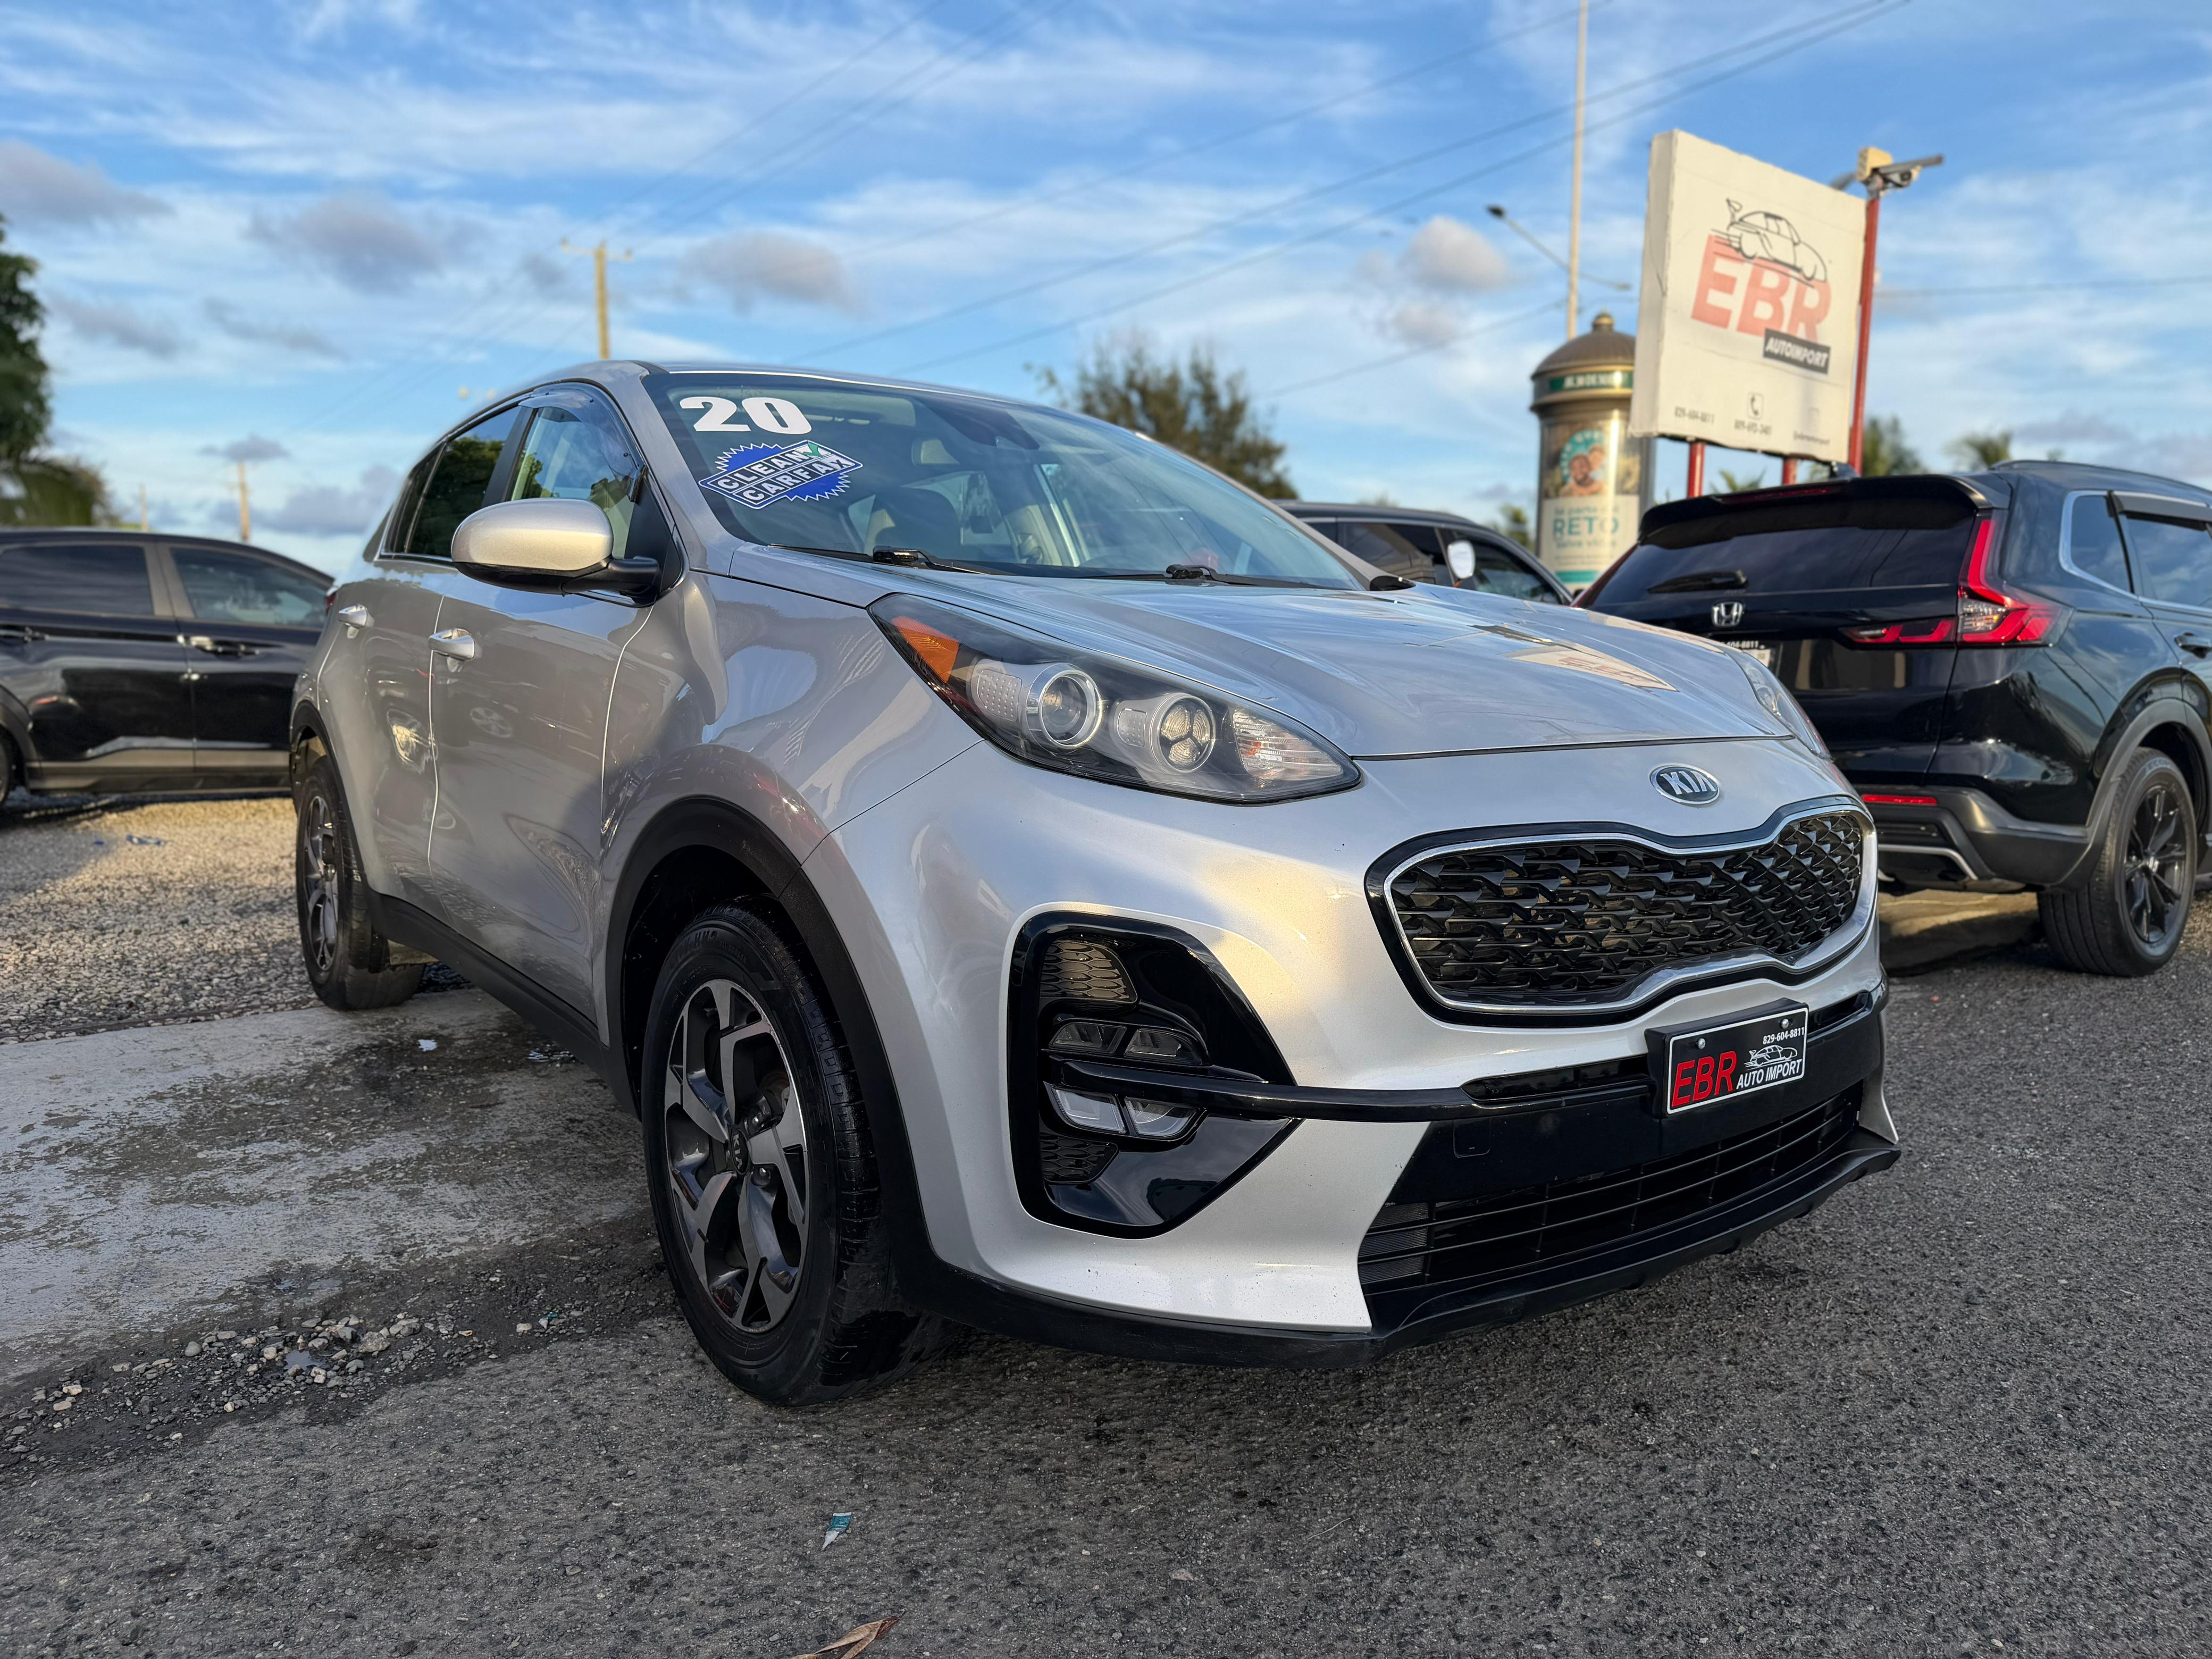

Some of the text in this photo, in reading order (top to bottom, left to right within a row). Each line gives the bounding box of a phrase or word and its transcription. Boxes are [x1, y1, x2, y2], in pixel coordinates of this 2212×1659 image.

[1691, 234, 1831, 344] EBR
[1766, 337, 1828, 367] AUTOIMPORT
[680, 397, 812, 434] 20
[718, 451, 810, 489] CLEAN
[743, 459, 847, 500] CARFAX
[1553, 516, 1619, 541] RETO
[1660, 771, 1716, 795] KIA
[1763, 1027, 1804, 1044] 829-604-8811
[1672, 1051, 1737, 1107] EBR
[1736, 1059, 1802, 1090] AUTO IMPORT
[733, 1133, 743, 1170] KIA
